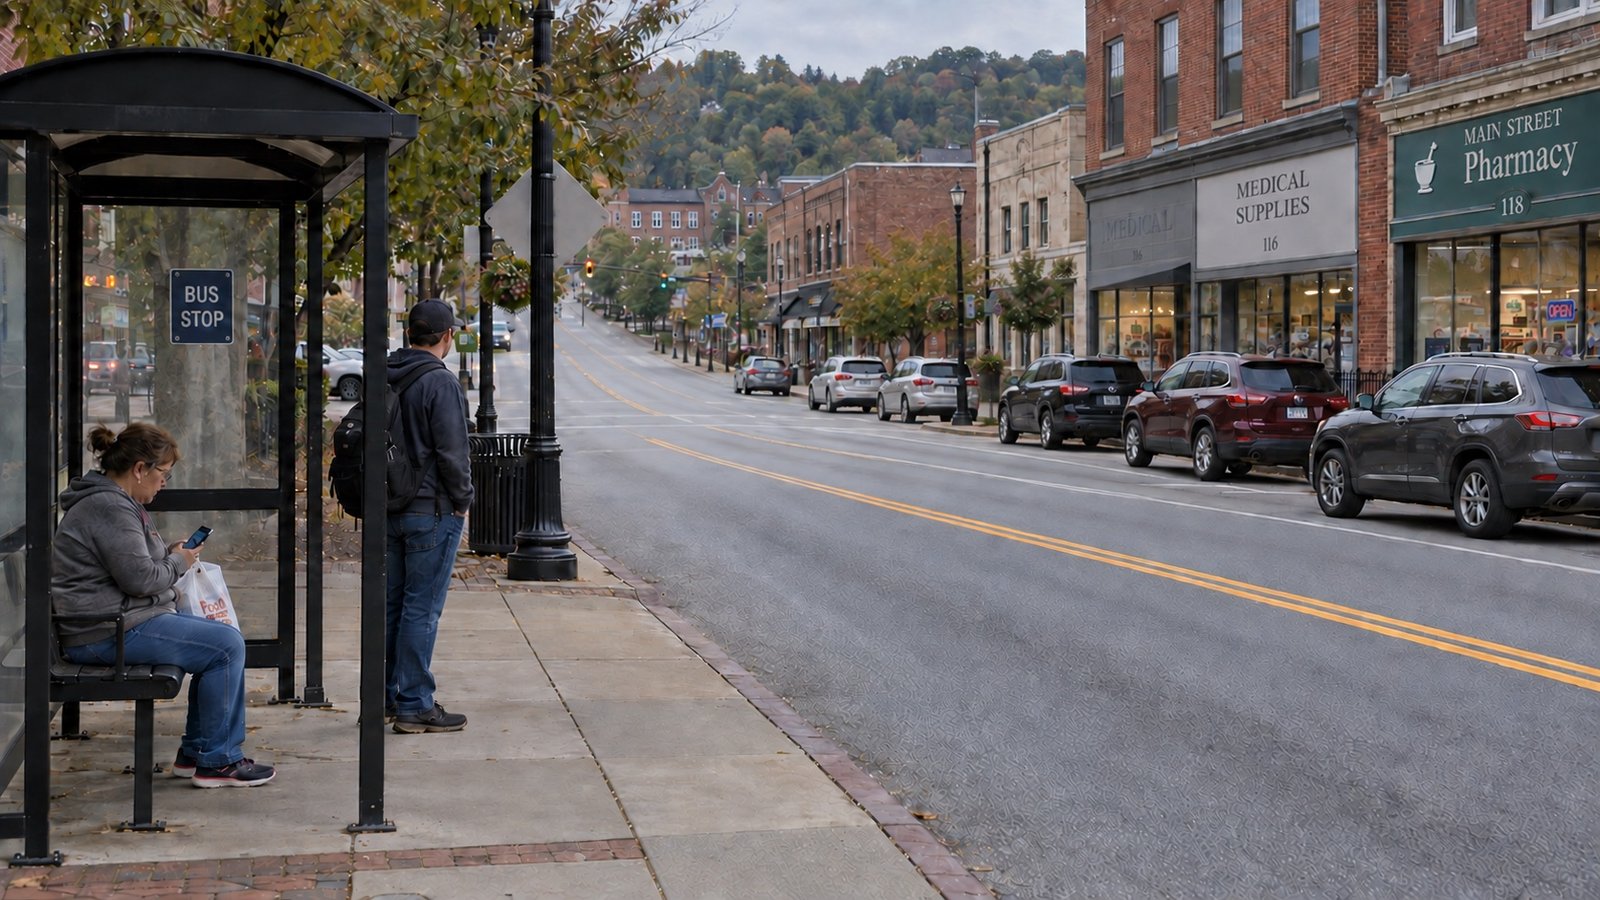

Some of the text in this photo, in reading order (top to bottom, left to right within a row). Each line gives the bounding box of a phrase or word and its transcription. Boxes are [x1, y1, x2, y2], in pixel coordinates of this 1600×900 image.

[1464, 107, 1563, 146] MAIN STREET
[1464, 141, 1578, 184] Pharmacy
[1236, 170, 1310, 200] MEDICAL
[1236, 195, 1310, 225] SUPPLIES
[1501, 195, 1524, 217] 118
[1104, 209, 1173, 242] MEDICAL
[1263, 235, 1279, 252] 116
[184, 285, 219, 303] BUS
[180, 310, 224, 328] STOP
[1548, 303, 1572, 318] OPEN
